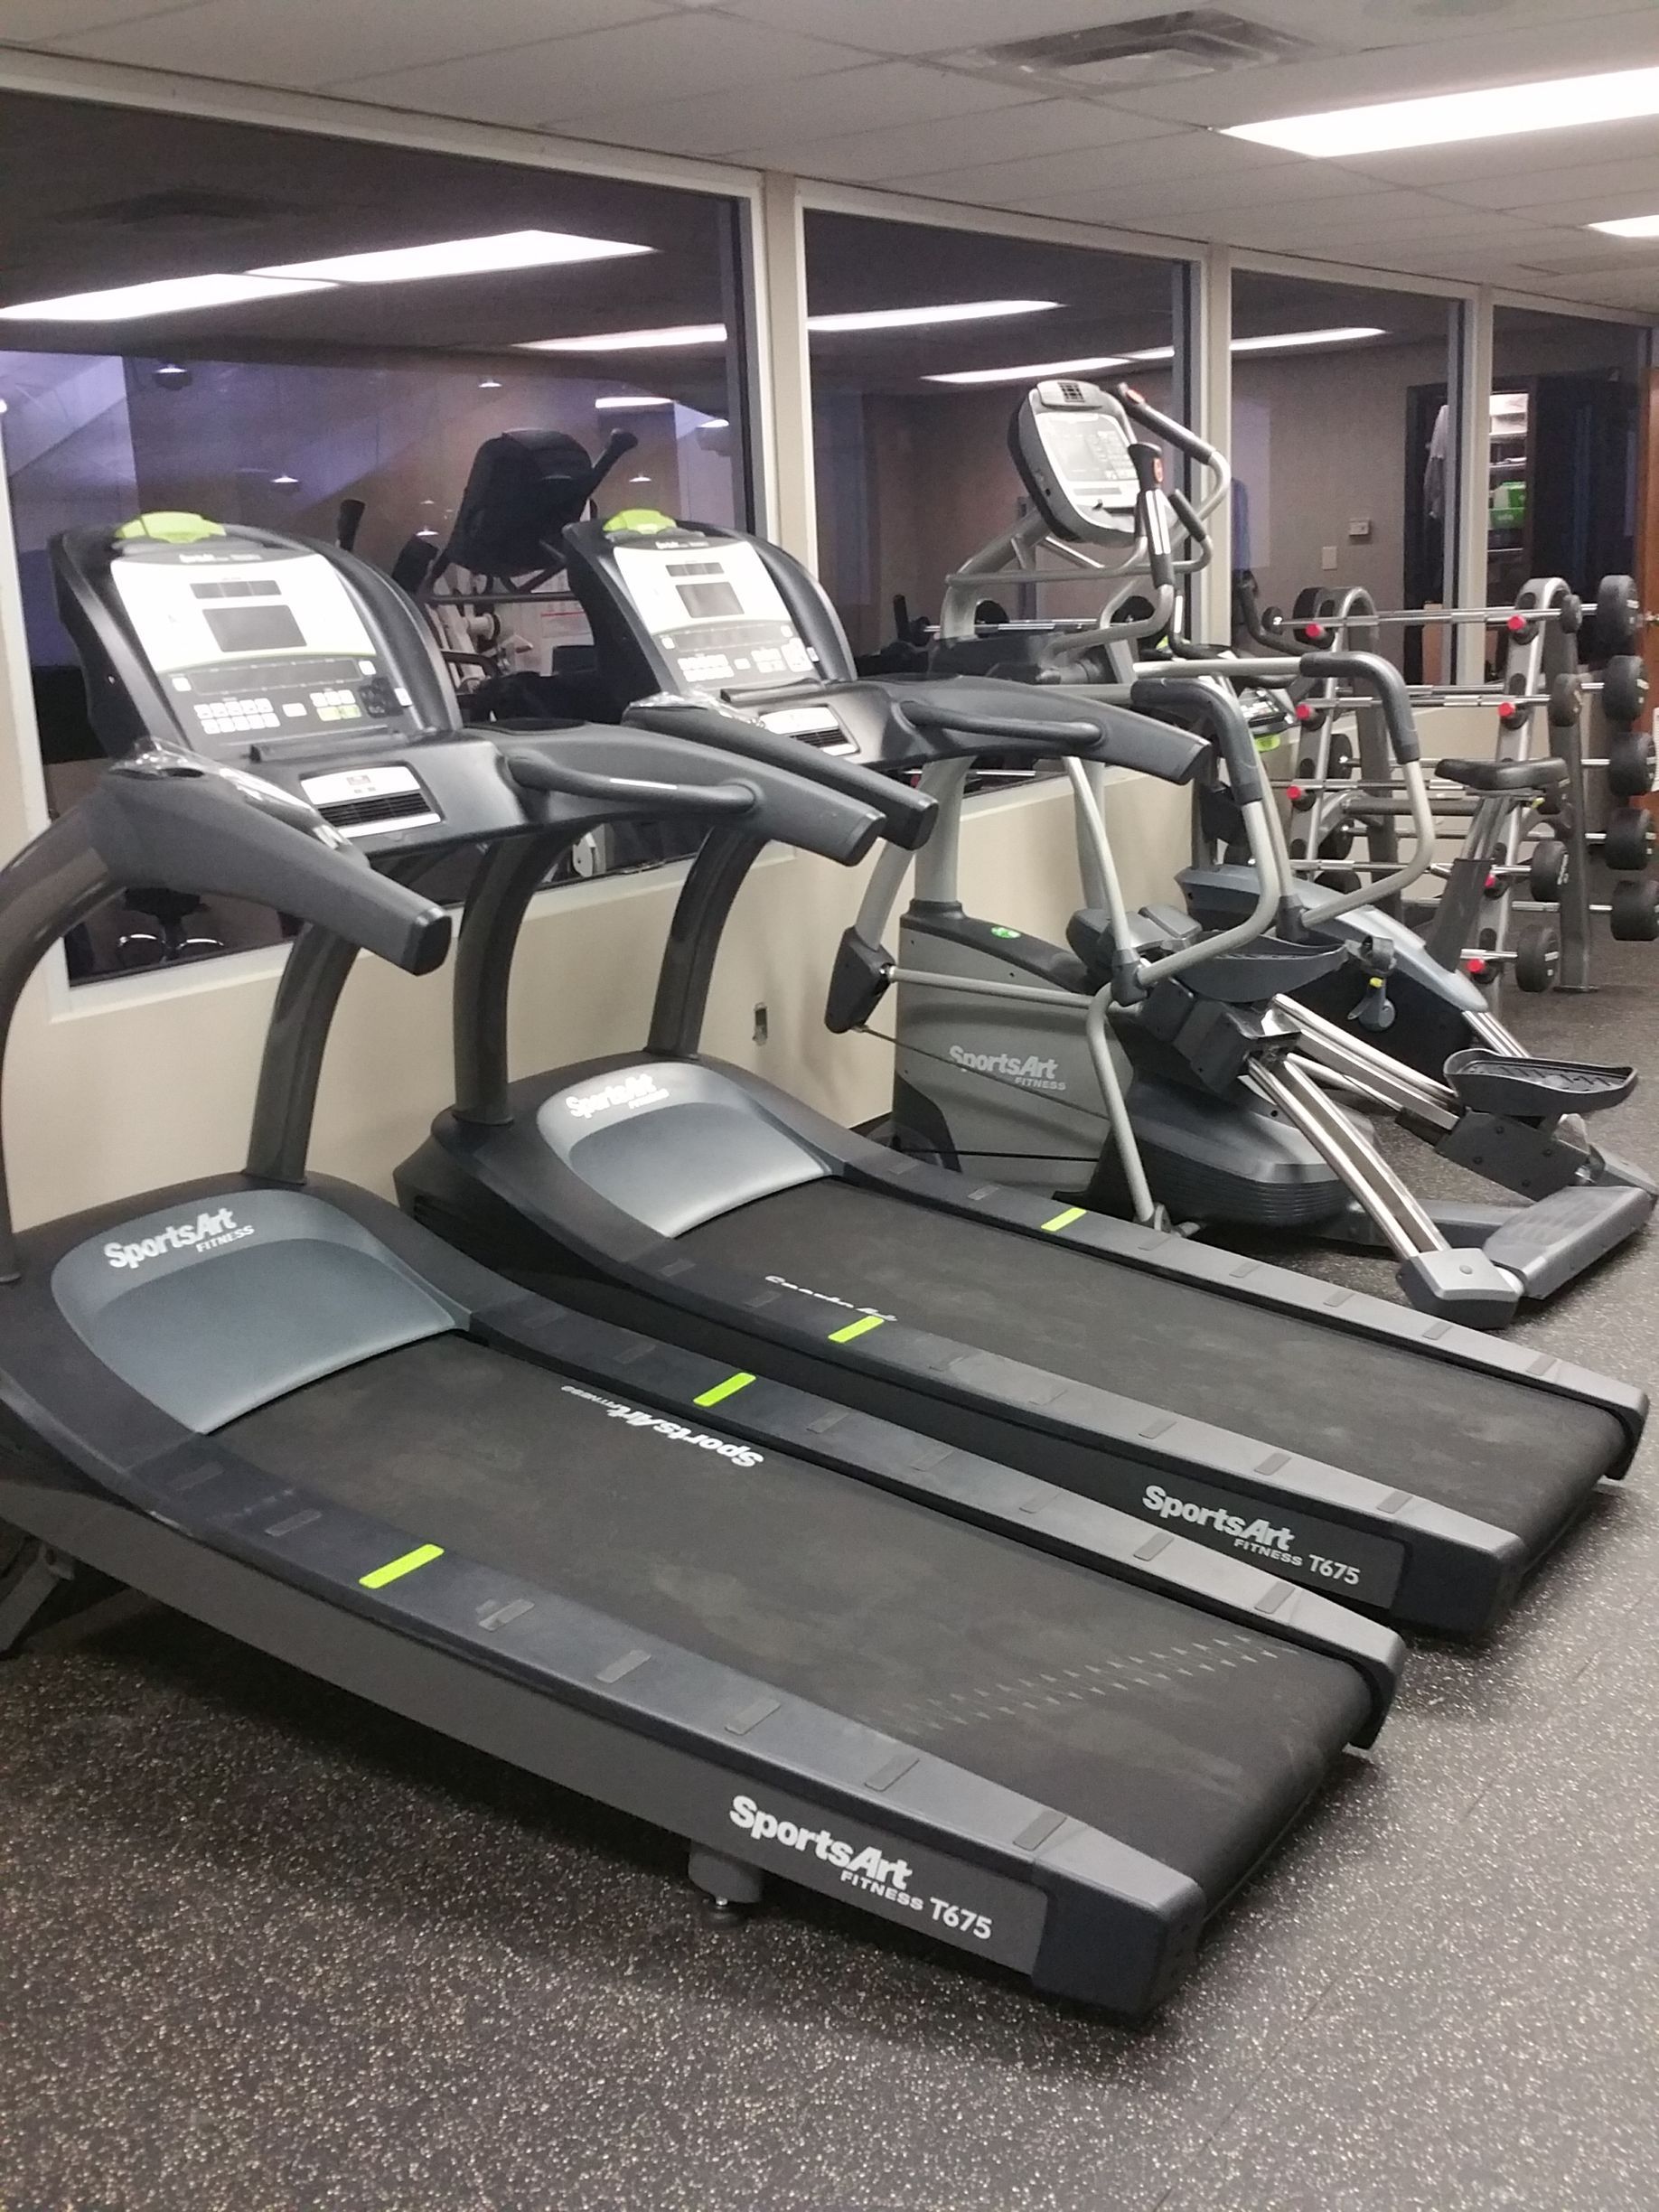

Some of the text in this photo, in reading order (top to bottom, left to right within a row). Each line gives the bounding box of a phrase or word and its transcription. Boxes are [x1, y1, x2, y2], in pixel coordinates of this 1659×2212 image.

[950, 1045, 1058, 1079] SportsArt
[1015, 1076, 1066, 1091] FITNESS
[104, 1207, 237, 1269] SportsArt
[196, 1225, 255, 1252] FITNESS
[606, 1403, 764, 1467] SportsArt
[1142, 1485, 1295, 1551] SportsArt
[1233, 1538, 1361, 1586] FITNESS T675
[729, 1795, 913, 1890] SportsArt
[840, 1870, 993, 1940] FITNESS T675
